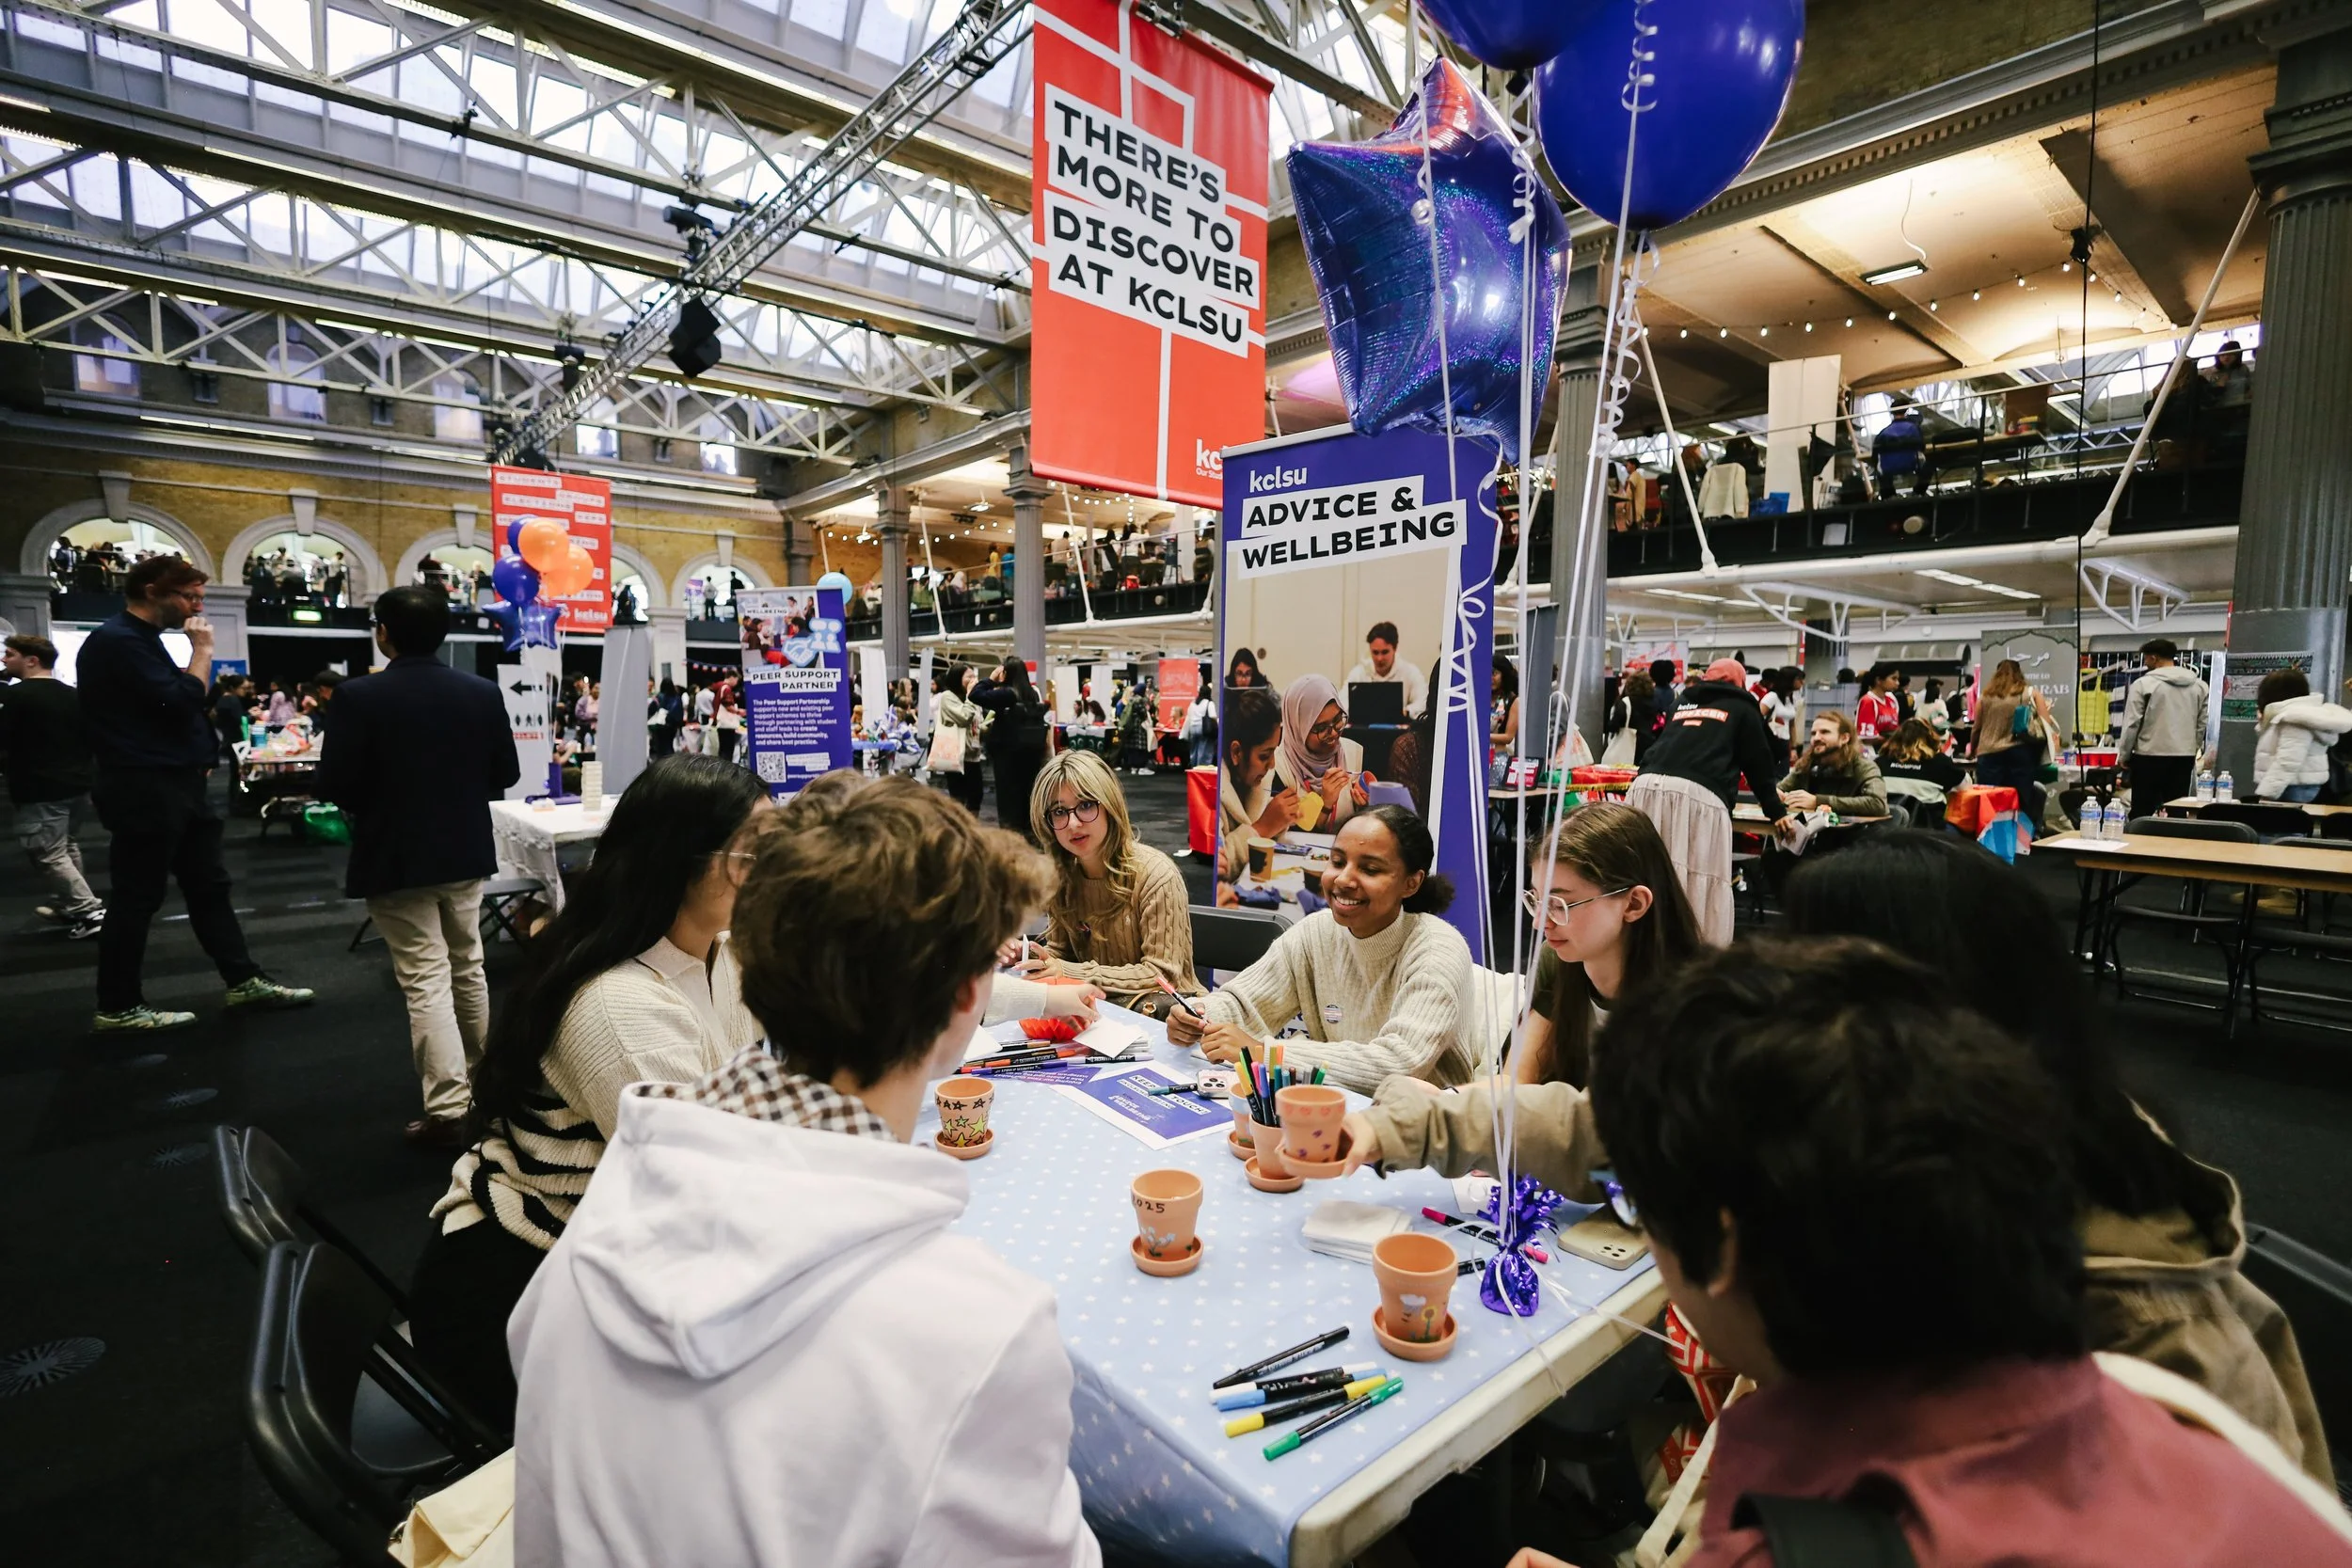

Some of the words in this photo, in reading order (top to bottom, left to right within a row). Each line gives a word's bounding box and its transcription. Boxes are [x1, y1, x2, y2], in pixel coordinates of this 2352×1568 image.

[1055, 100, 1219, 203] THERE'S
[1057, 145, 1172, 227] MORE
[1186, 207, 1234, 253] TO
[1053, 205, 1254, 297] DISCOVER
[1057, 253, 1113, 295] AT
[1129, 277, 1242, 342] KCLSU
[1249, 466, 1308, 493] kclsu
[1246, 491, 1377, 529] ADVICE
[1391, 486, 1417, 513] &
[1242, 511, 1458, 569] WELLBEING
[753, 672, 781, 681] PEER
[782, 681, 834, 689] PARTNER
[1132, 1076, 1156, 1088] KEEP
